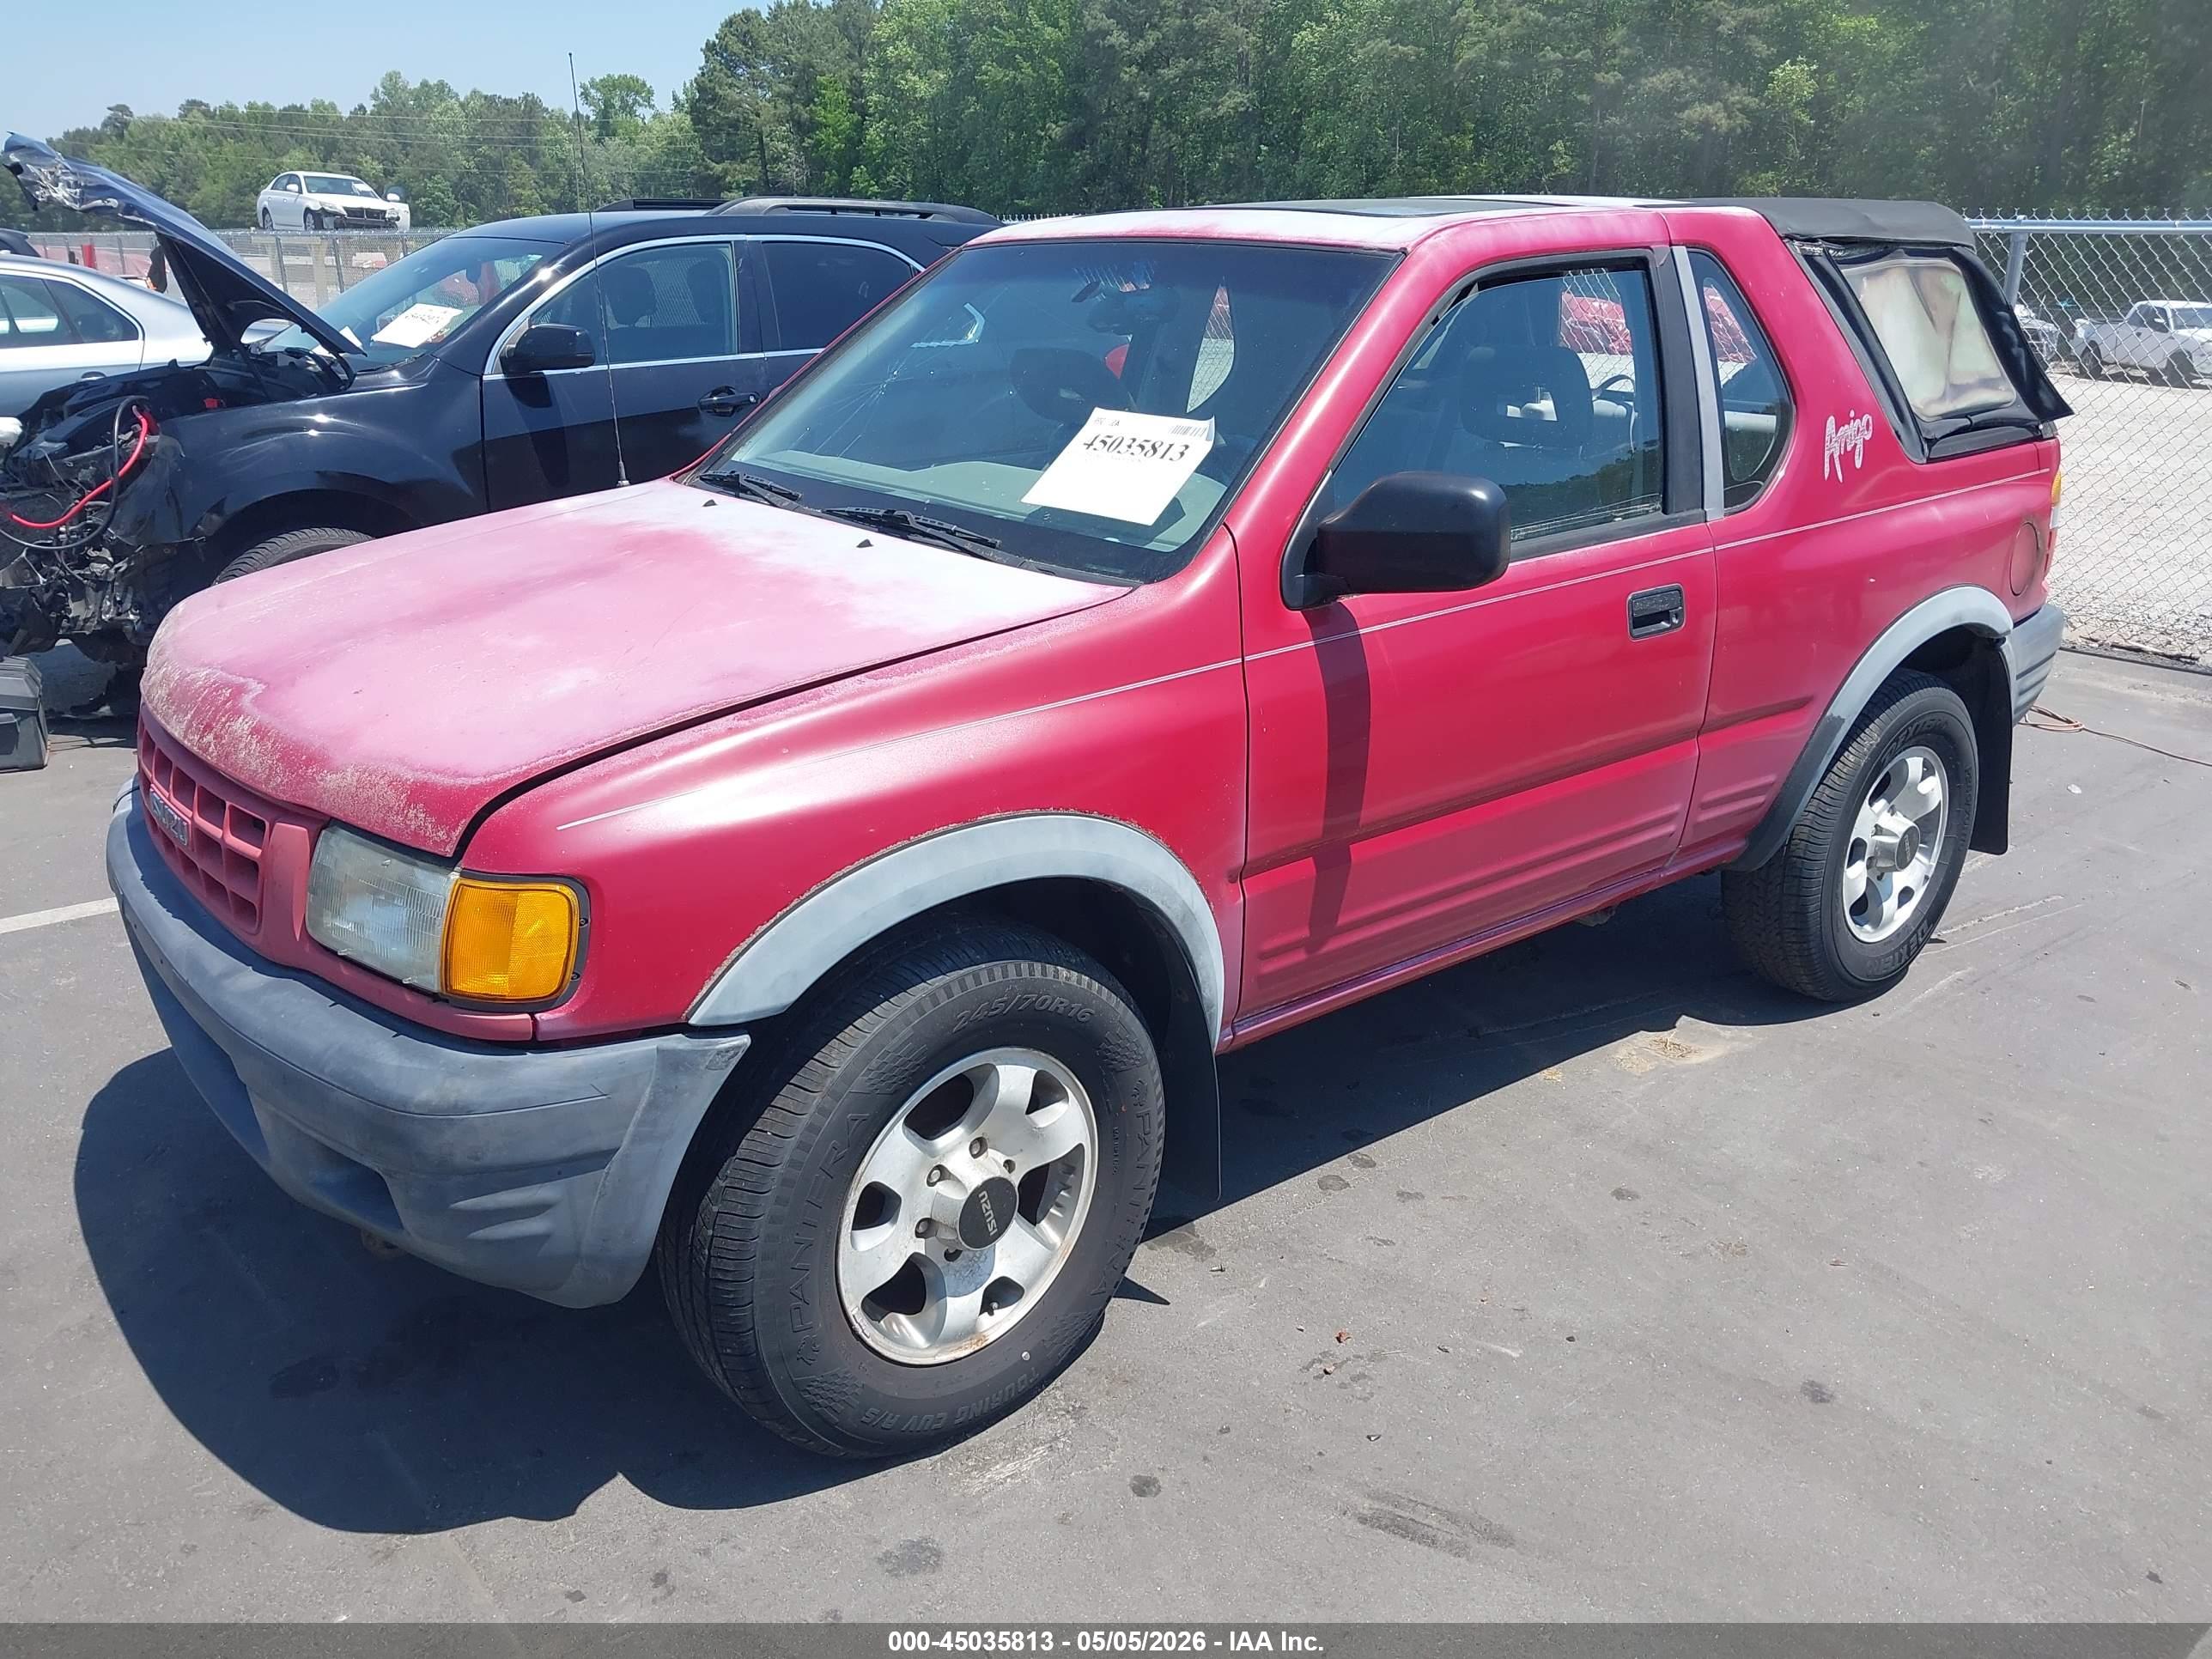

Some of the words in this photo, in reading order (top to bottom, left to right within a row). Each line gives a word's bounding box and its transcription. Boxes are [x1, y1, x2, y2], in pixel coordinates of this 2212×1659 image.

[1083, 434, 1190, 461] 45035813
[1825, 410, 1873, 483] Amigo
[952, 994, 1096, 1034] 245/70R16
[789, 1113, 871, 1334] PANTERA
[979, 1190, 999, 1237] ISUZU
[954, 1366, 1040, 1425] TOURING
